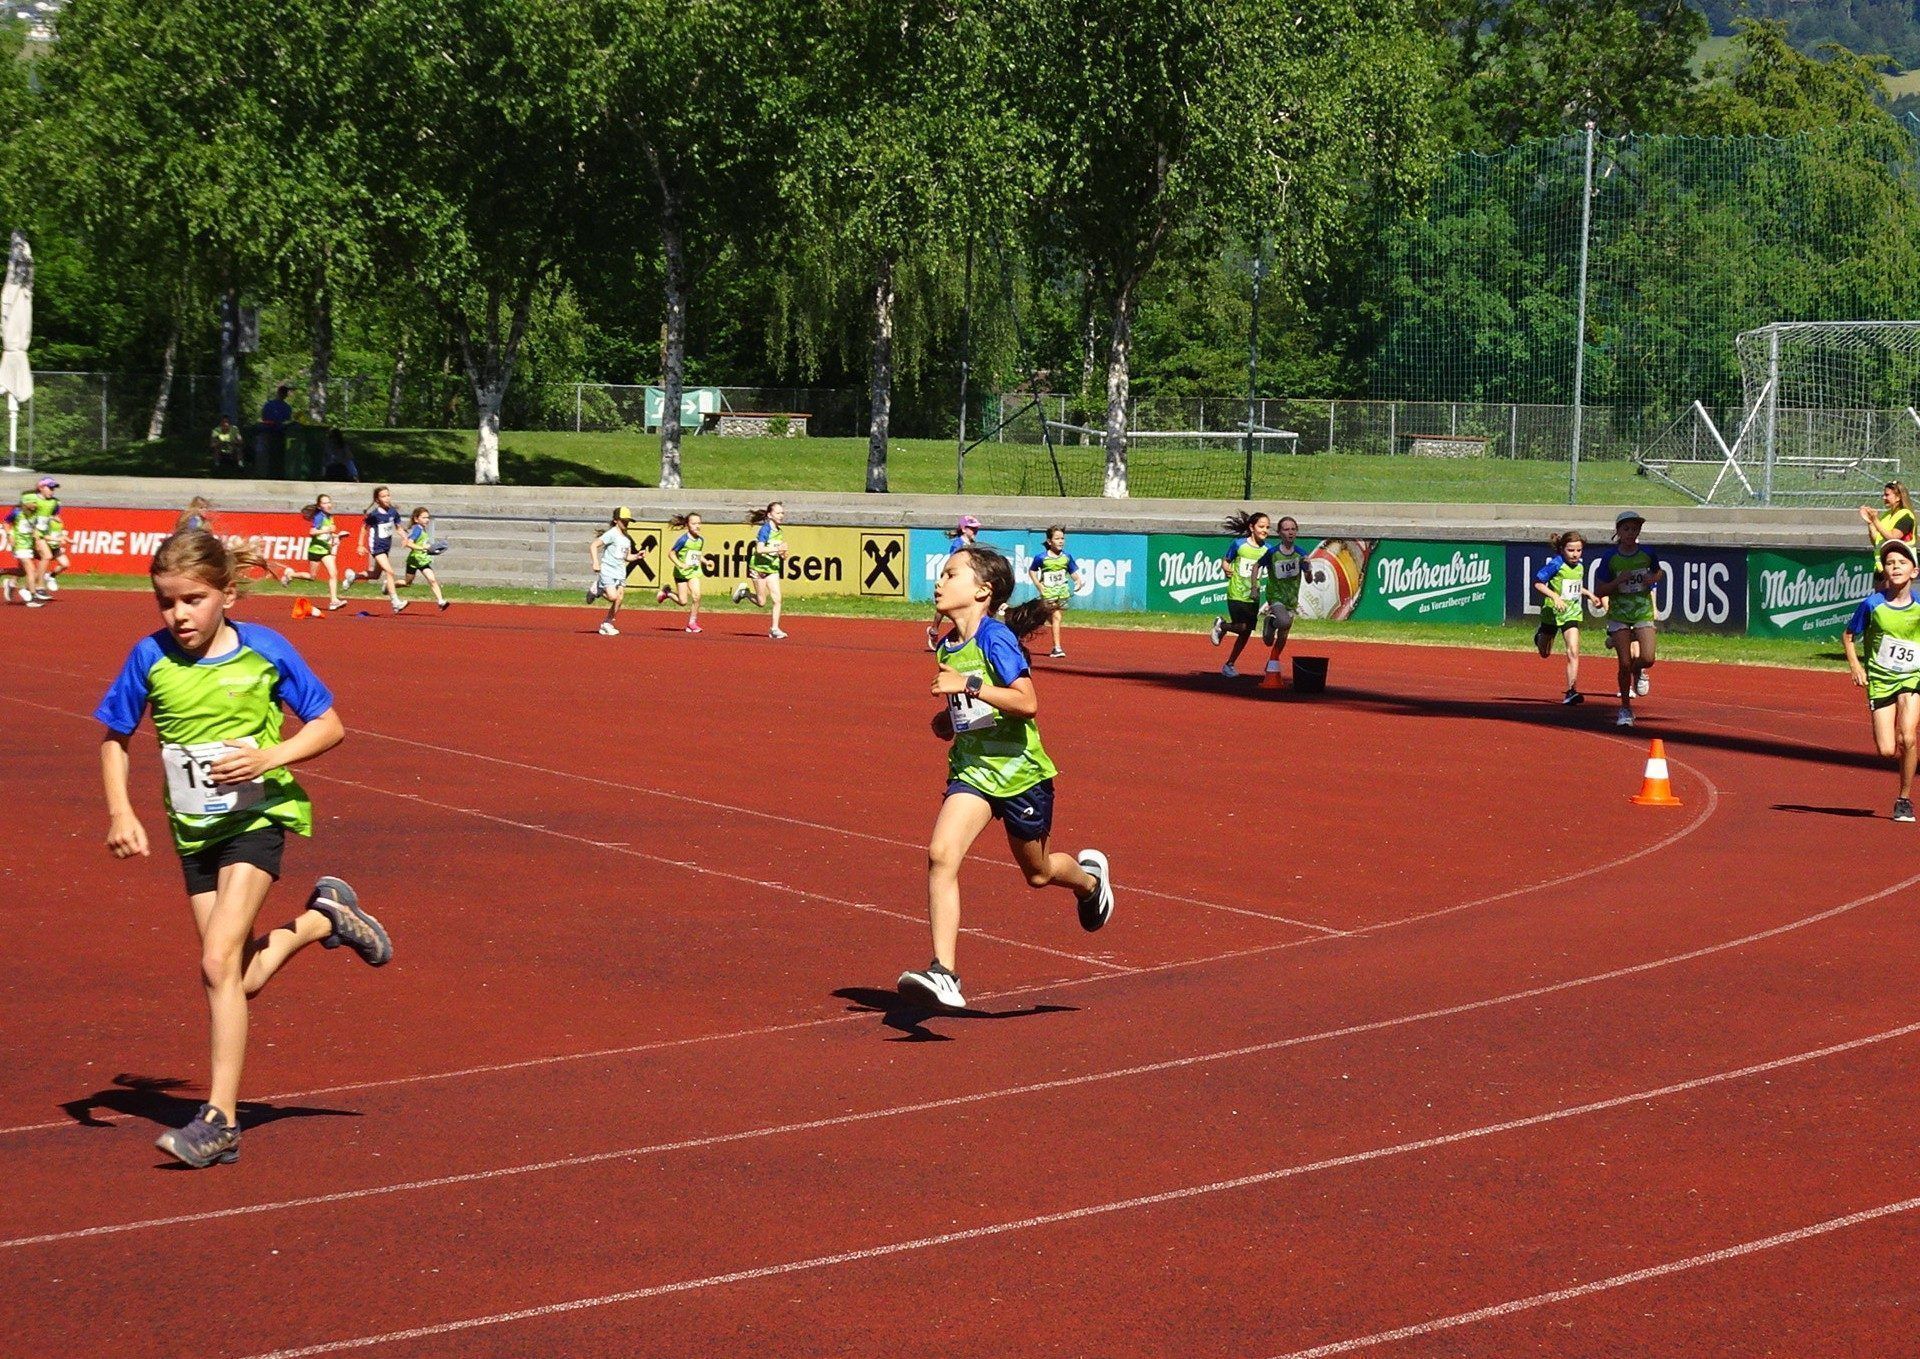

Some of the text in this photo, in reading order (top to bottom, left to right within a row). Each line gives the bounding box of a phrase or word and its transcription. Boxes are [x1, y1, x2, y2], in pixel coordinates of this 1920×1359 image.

[71, 530, 127, 555] IHRE
[700, 540, 842, 581] aiffsen
[1280, 562, 1296, 572] 104
[1378, 551, 1491, 594] Mohrenbräu
[1760, 562, 1876, 609] Mohrenbräu
[1419, 603, 1430, 613] das
[1889, 645, 1915, 662] 135
[182, 760, 219, 788] 13
